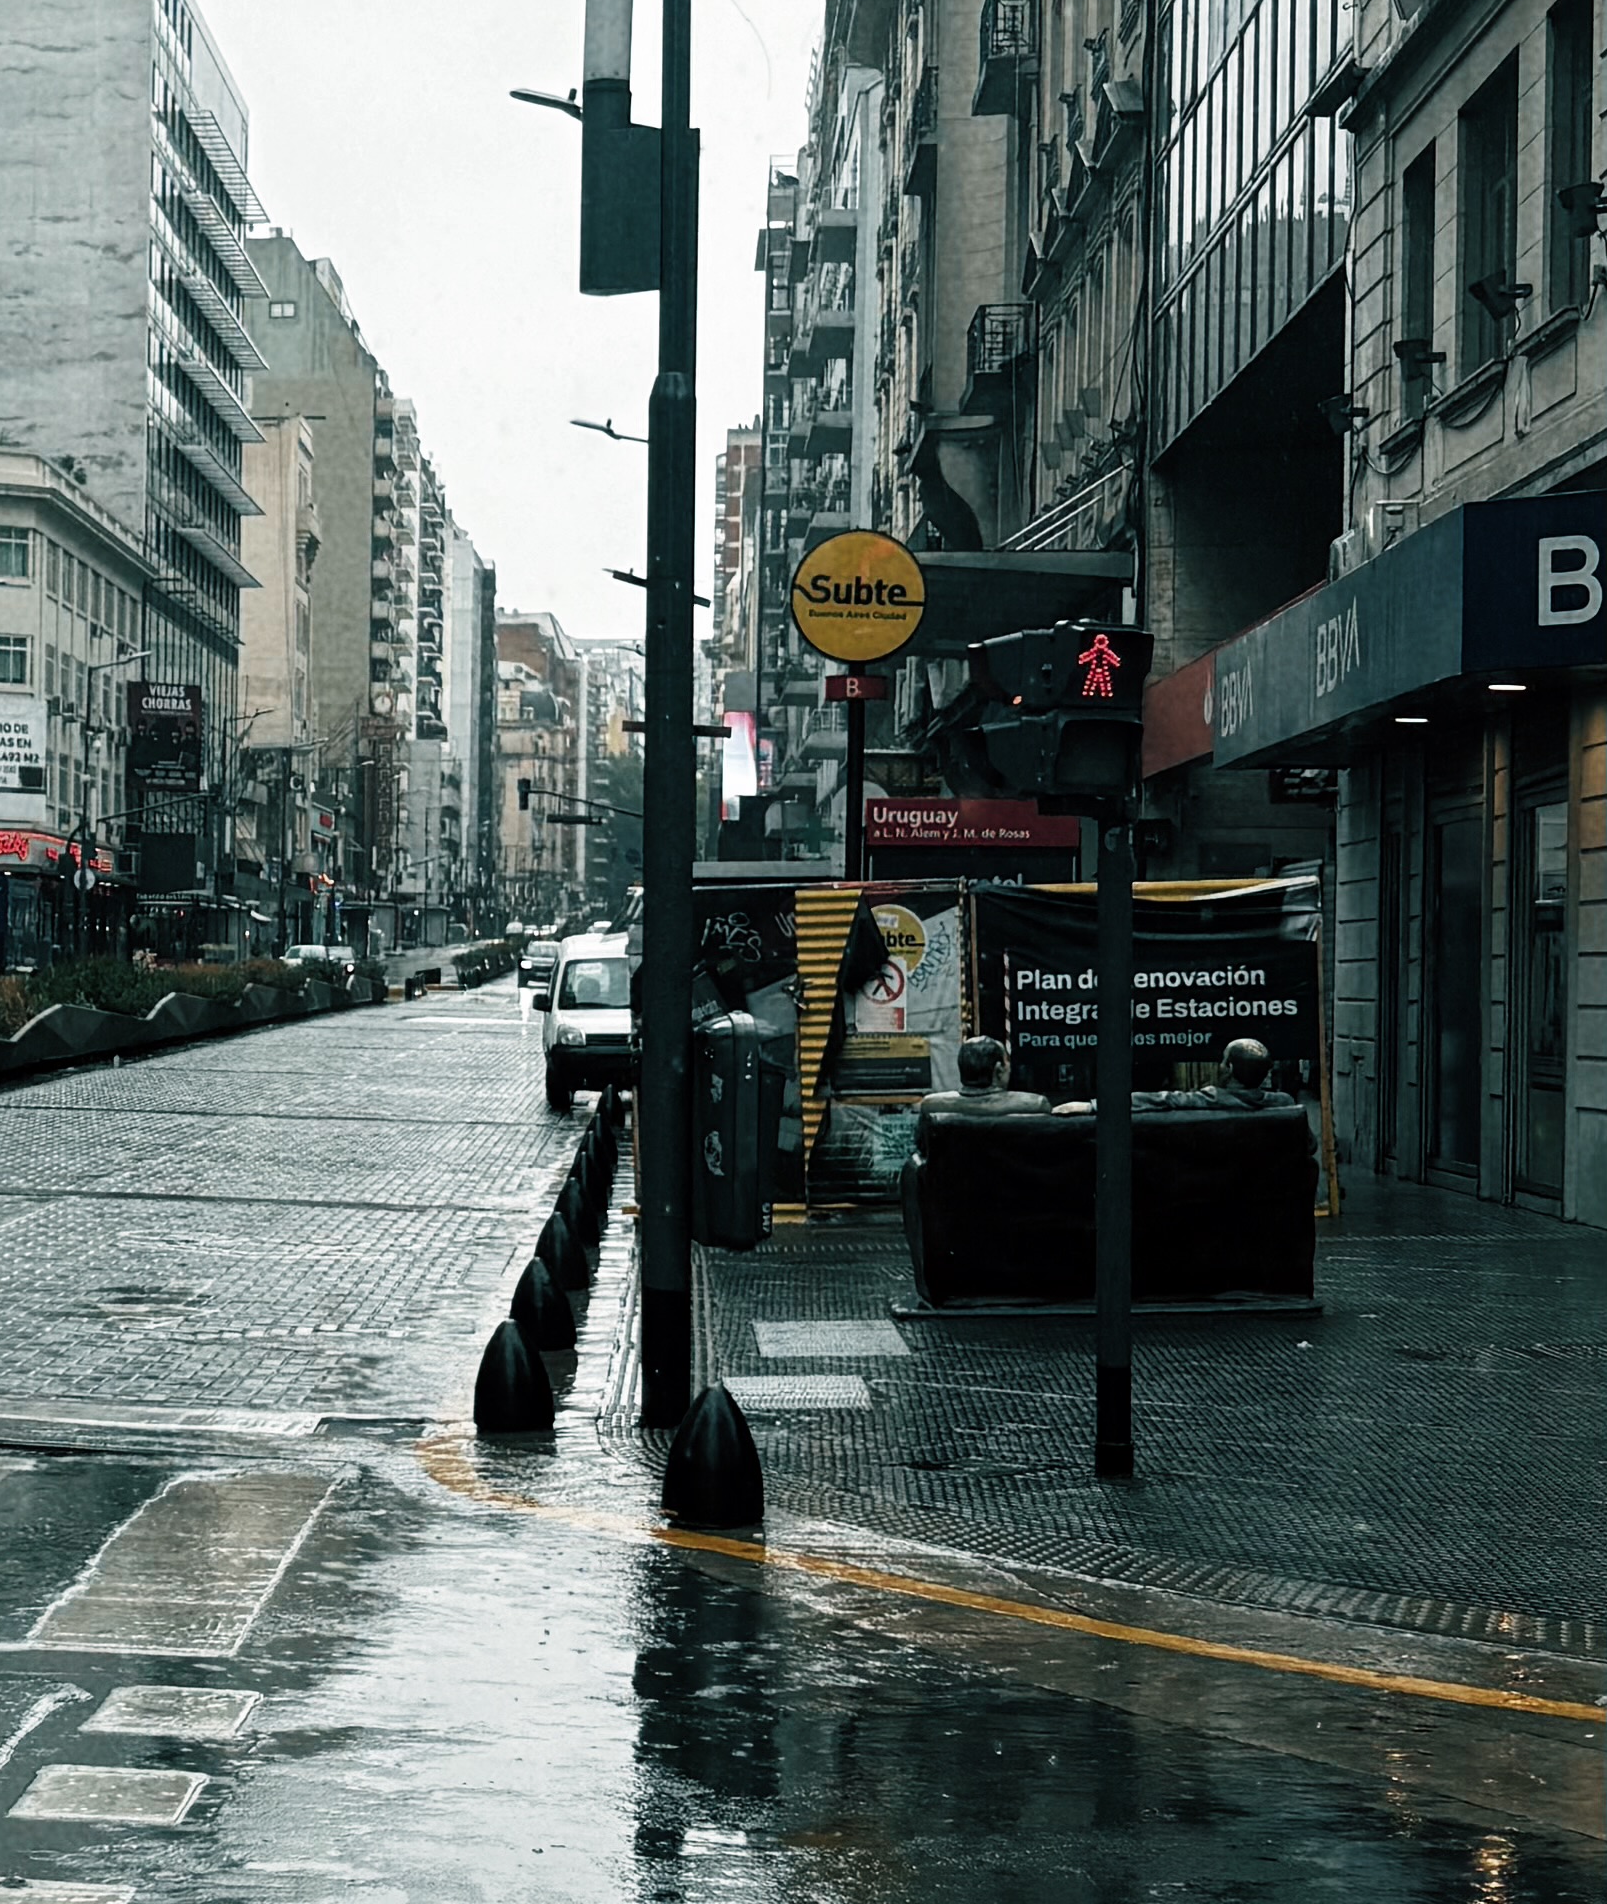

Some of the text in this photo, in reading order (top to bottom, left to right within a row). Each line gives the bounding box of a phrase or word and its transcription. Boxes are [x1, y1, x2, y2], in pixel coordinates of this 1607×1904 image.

[807, 574, 912, 607] Subte
[1538, 534, 1603, 627] B
[808, 608, 907, 620] Buenos Aires Ciudad
[1315, 594, 1360, 698] BBVA
[141, 697, 192, 711] CHORRAS
[1219, 655, 1254, 738] BBVA
[13, 723, 29, 734] DE
[16, 738, 32, 748] EN
[872, 806, 959, 828] Uruguay
[910, 828, 941, 839] Alem
[981, 828, 997, 839] de
[998, 828, 1031, 840] Rosas
[1016, 969, 1073, 990] Plan
[1133, 964, 1267, 988] enovación
[1156, 996, 1299, 1019] Estaciones
[1017, 1031, 1061, 1048] Para
[1063, 1032, 1099, 1050] que
[1159, 1029, 1214, 1048] mejor
